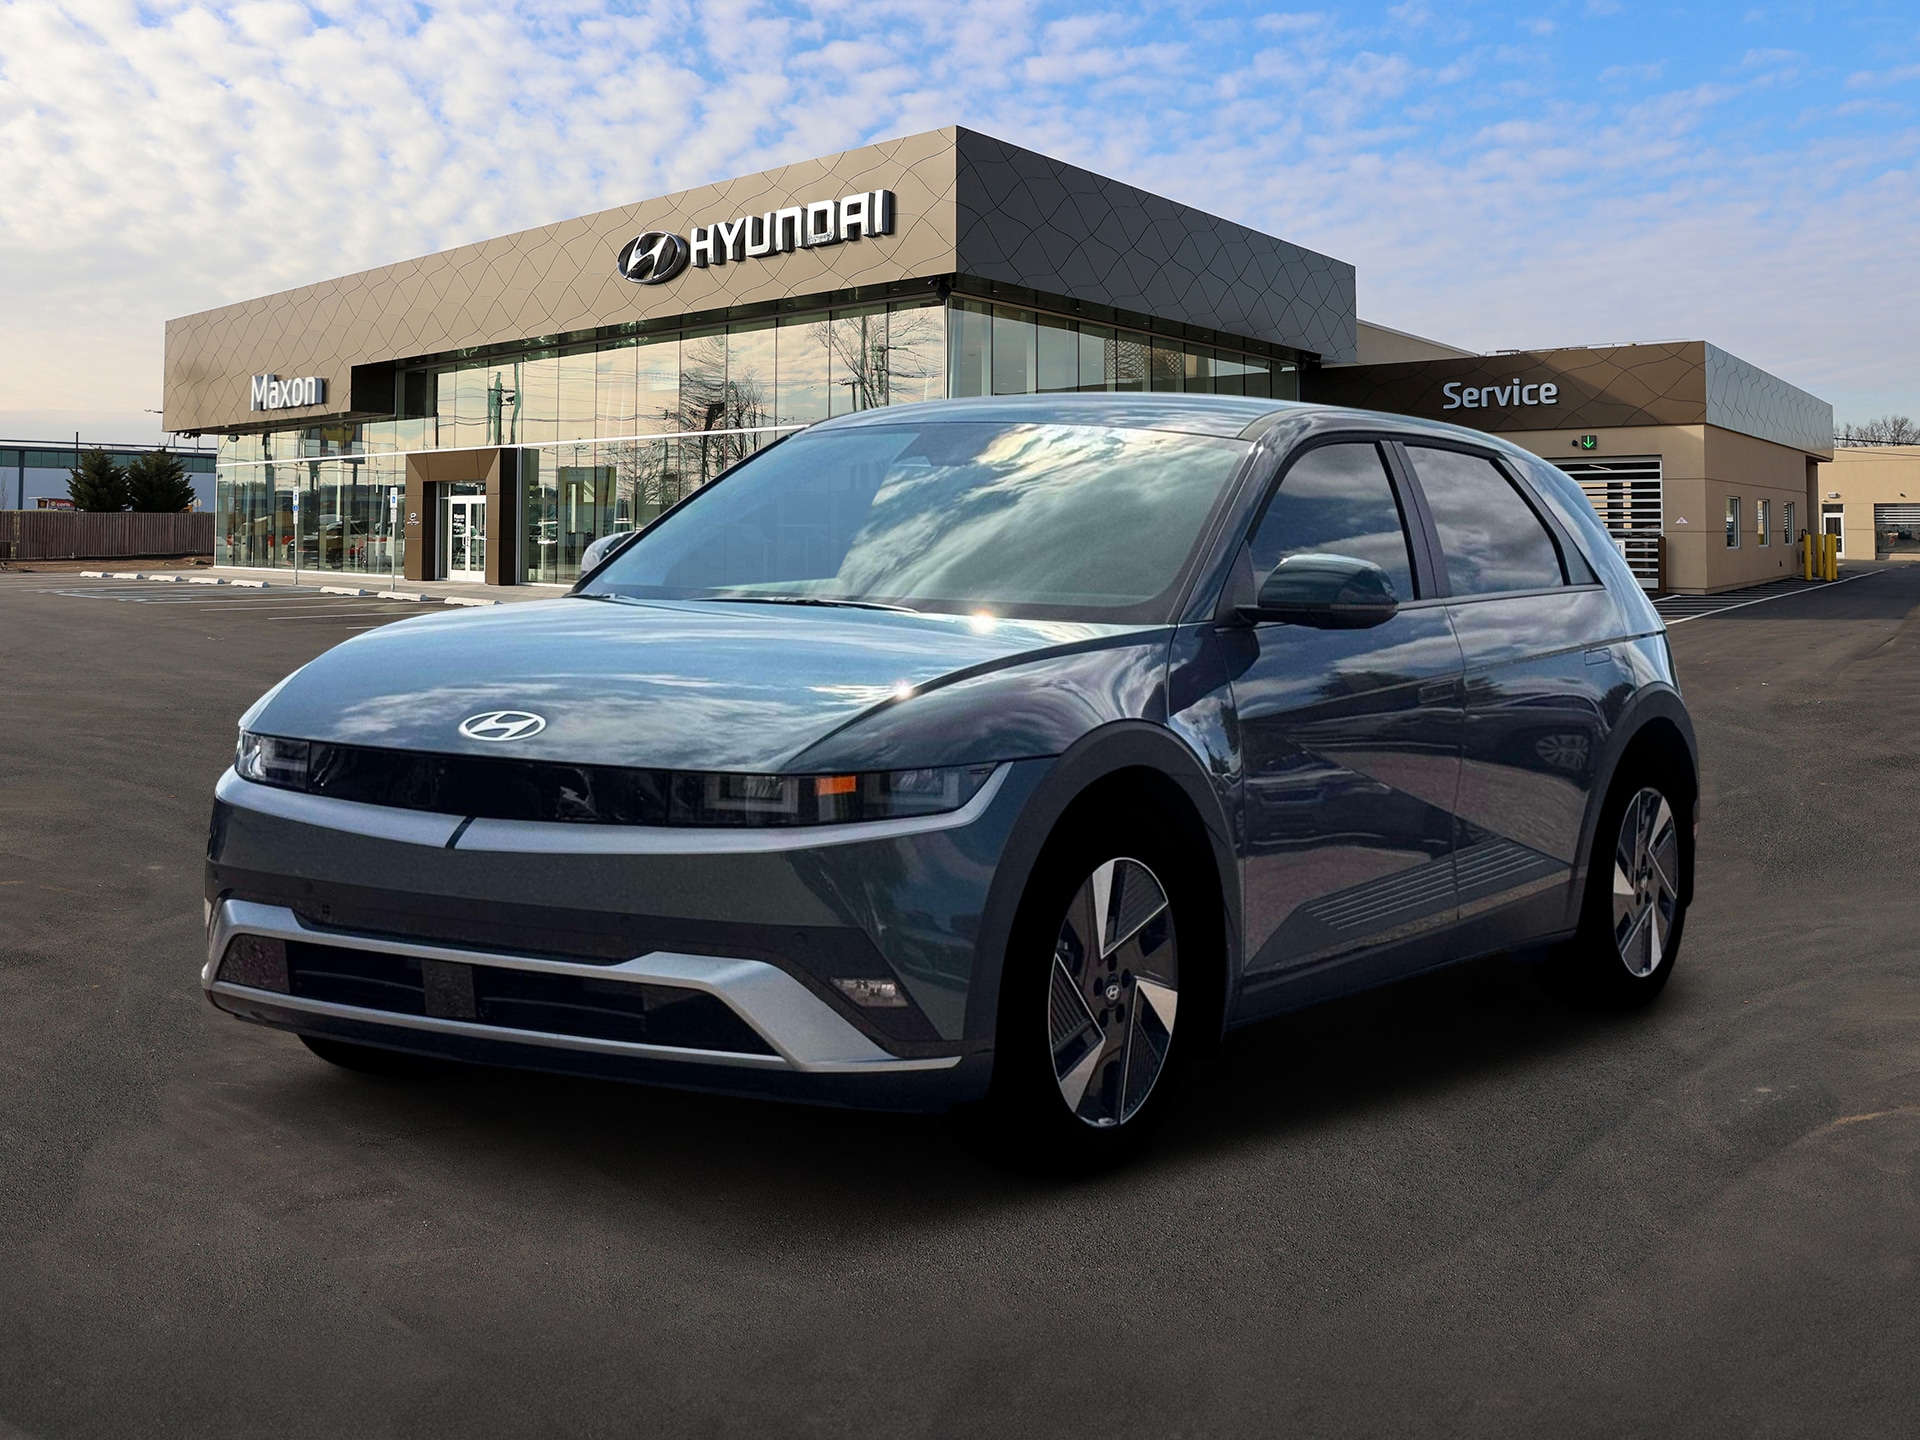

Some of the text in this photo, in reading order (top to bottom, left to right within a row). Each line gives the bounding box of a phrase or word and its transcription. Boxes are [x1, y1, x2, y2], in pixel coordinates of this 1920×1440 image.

[690, 189, 895, 268] HYUNDAI
[250, 373, 321, 411] Maxon
[1442, 377, 1558, 409] Service
